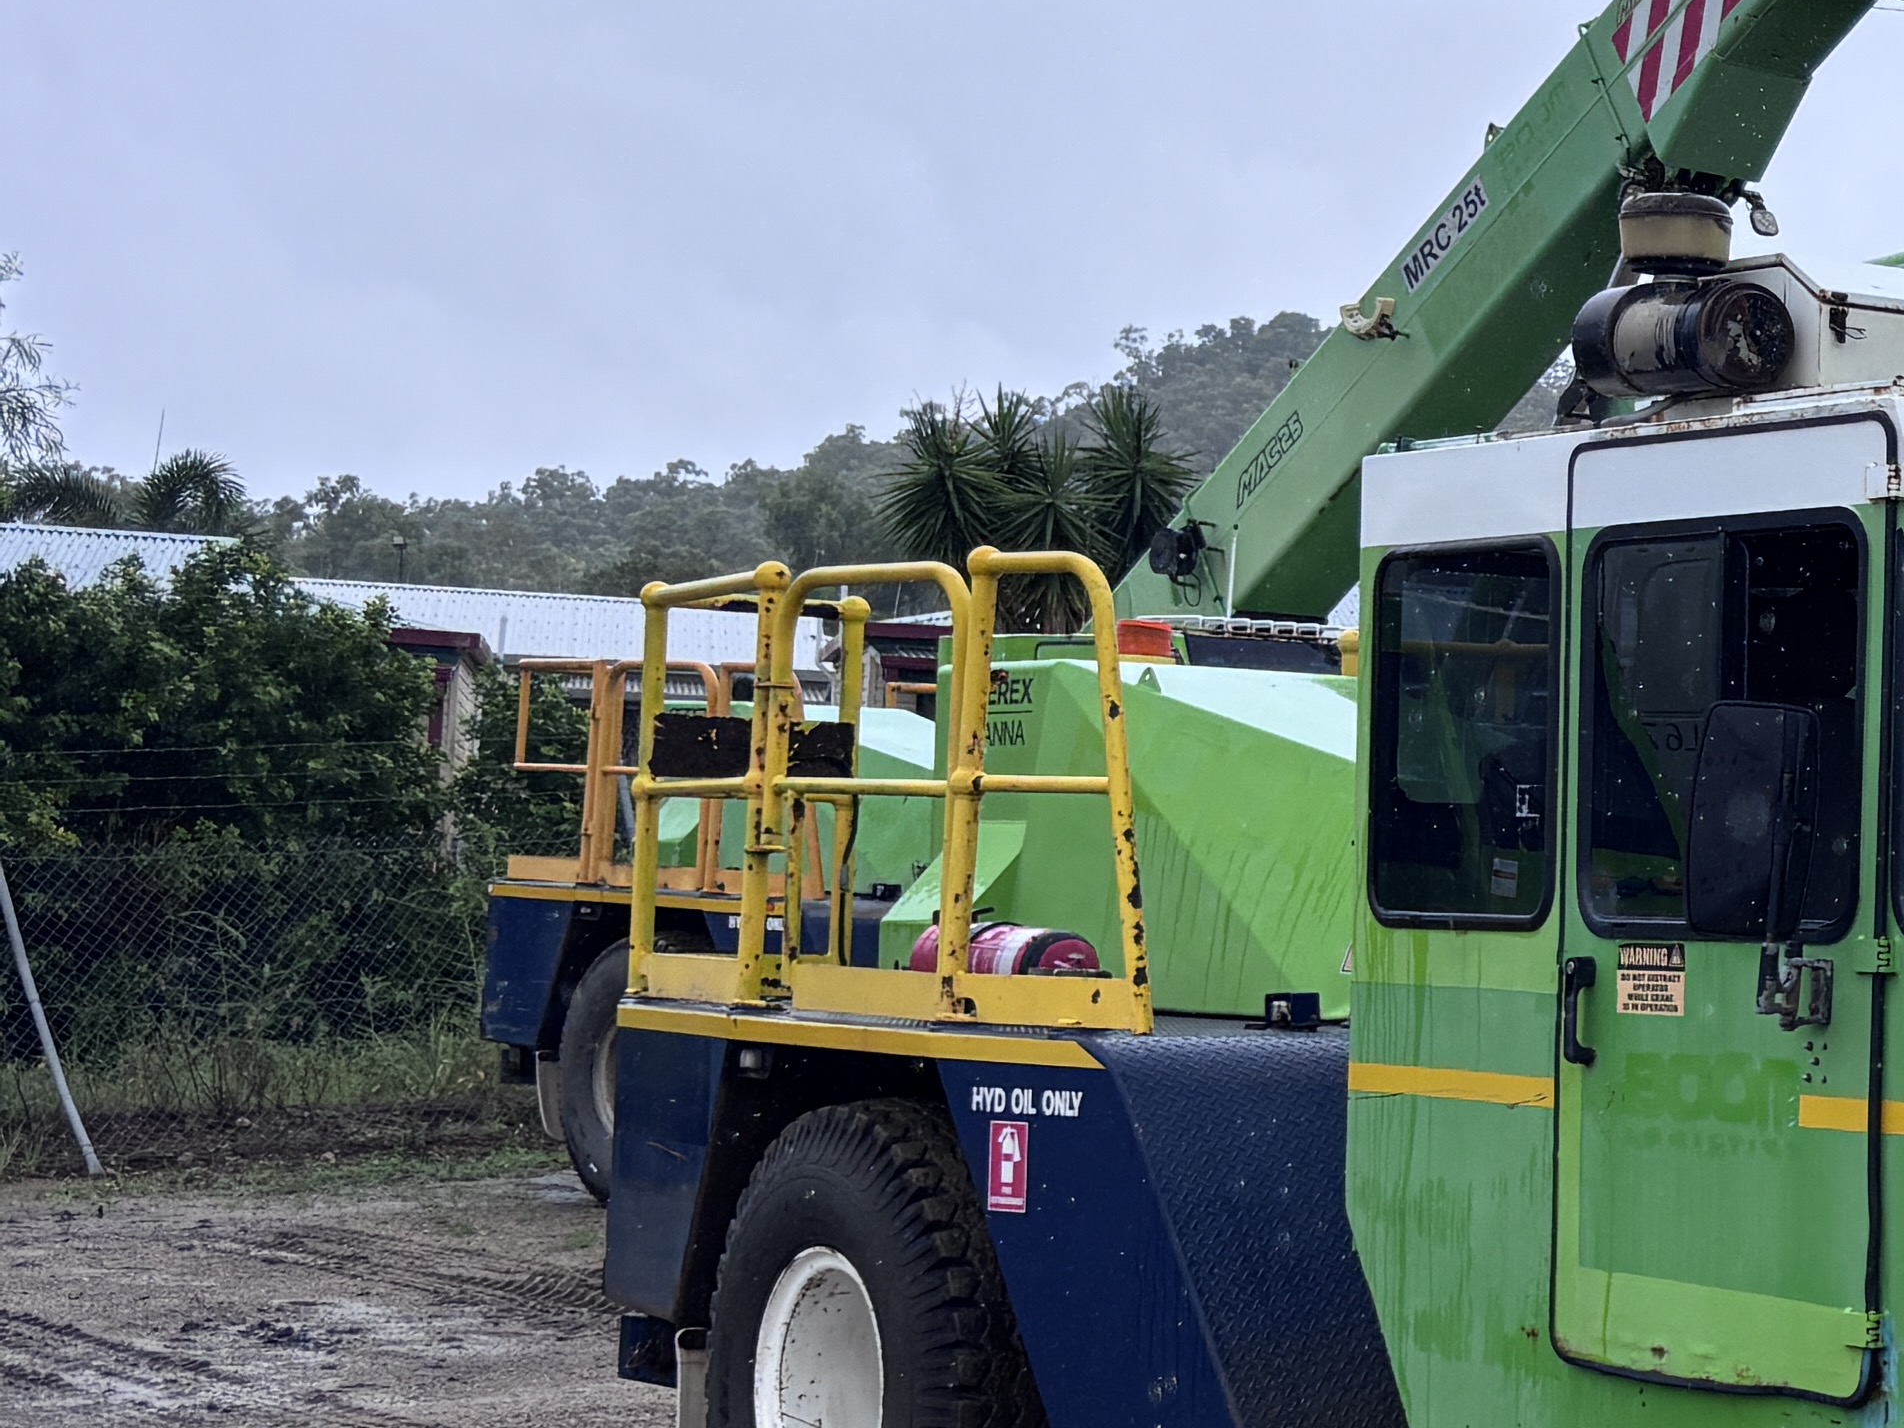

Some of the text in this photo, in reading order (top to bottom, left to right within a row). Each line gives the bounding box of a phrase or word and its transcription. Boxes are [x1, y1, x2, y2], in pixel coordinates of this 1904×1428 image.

[1403, 185, 1486, 289] MRC 25t
[1236, 410, 1303, 510] MAC25
[987, 678, 1034, 705] EREX
[986, 721, 1025, 746] ANNA
[1620, 946, 1668, 967] WARNING
[971, 1086, 1083, 1117] HYD OIL ONLY
